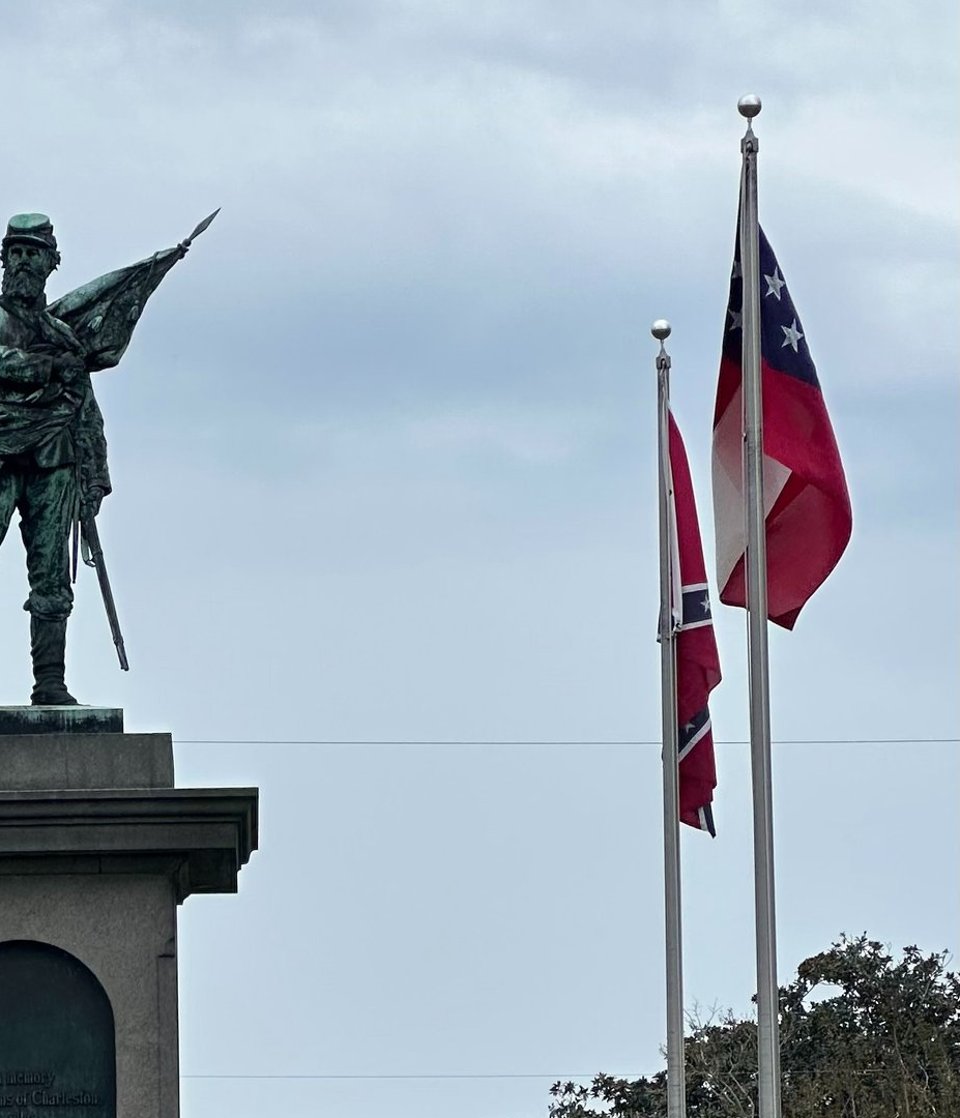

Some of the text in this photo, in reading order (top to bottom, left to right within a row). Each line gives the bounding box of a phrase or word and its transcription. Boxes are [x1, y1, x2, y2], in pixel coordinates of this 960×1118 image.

[6, 1069, 56, 1088] memory
[16, 1093, 29, 1106] of
[31, 1090, 98, 1106] Charleston
